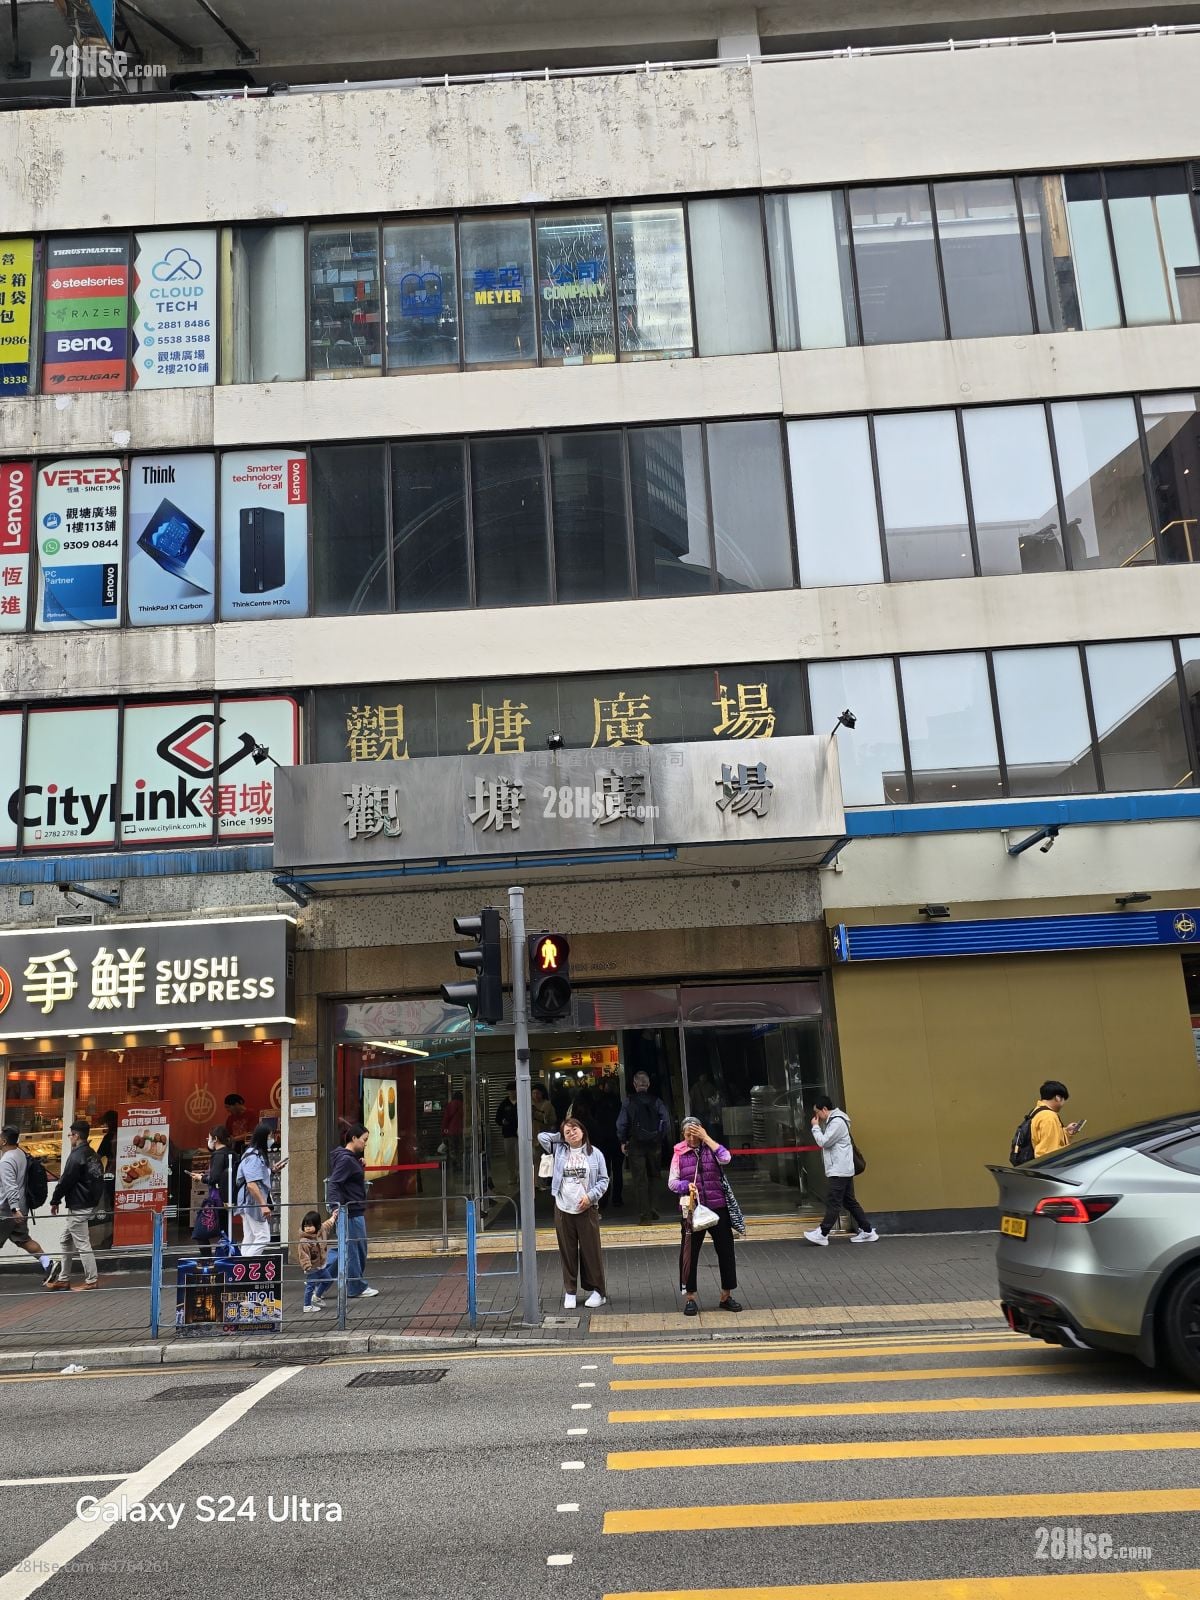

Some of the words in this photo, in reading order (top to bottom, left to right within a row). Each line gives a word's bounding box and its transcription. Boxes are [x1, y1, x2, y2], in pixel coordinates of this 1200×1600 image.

[53, 247, 124, 256] THRUSTMASTER
[62, 277, 124, 289] steelseries
[149, 286, 204, 299] CLOUD
[474, 289, 522, 305] MEYER
[543, 281, 607, 301] COMPANY
[156, 300, 198, 313] TECH
[71, 308, 121, 318] RAZER
[157, 321, 181, 330] 2881
[184, 320, 211, 328] 8486
[1, 335, 27, 346] 1986
[57, 336, 114, 353] BenQ
[157, 335, 183, 345] 5538
[185, 334, 211, 343] 3588
[157, 349, 206, 362] 觀塘廣場
[3, 375, 28, 385] 8338
[66, 373, 121, 382] COUGAR
[247, 464, 283, 473] Smarter
[43, 467, 121, 487] VERTEX
[142, 465, 176, 485] Think
[232, 473, 283, 483] technology
[258, 482, 272, 490] for
[273, 481, 283, 490] all
[291, 462, 301, 501] Lenovo
[2, 469, 24, 547] Lenovo
[66, 505, 117, 520] 觀塘廣場
[63, 541, 90, 550] 9309
[91, 539, 118, 548] 0844
[45, 570, 57, 578] PC
[45, 577, 75, 585] Partner
[104, 567, 115, 603] Lenovo
[138, 603, 169, 612] ThinkPad
[170, 603, 178, 611] X1
[178, 602, 204, 610] Carbon
[232, 600, 272, 608] ThinkCentre
[345, 683, 778, 762] 觀塘廣場
[8, 775, 203, 836] CityLink
[199, 780, 273, 820] 領域
[342, 761, 776, 841] 觀塘廣場
[138, 822, 208, 833] www.citylink.com.hk
[220, 817, 246, 828] Since
[249, 816, 273, 827] 1995
[44, 830, 61, 838] 2782
[61, 829, 78, 837] 2782
[22, 946, 146, 1014] 爭鮮
[155, 976, 275, 1005] EXPRESS
